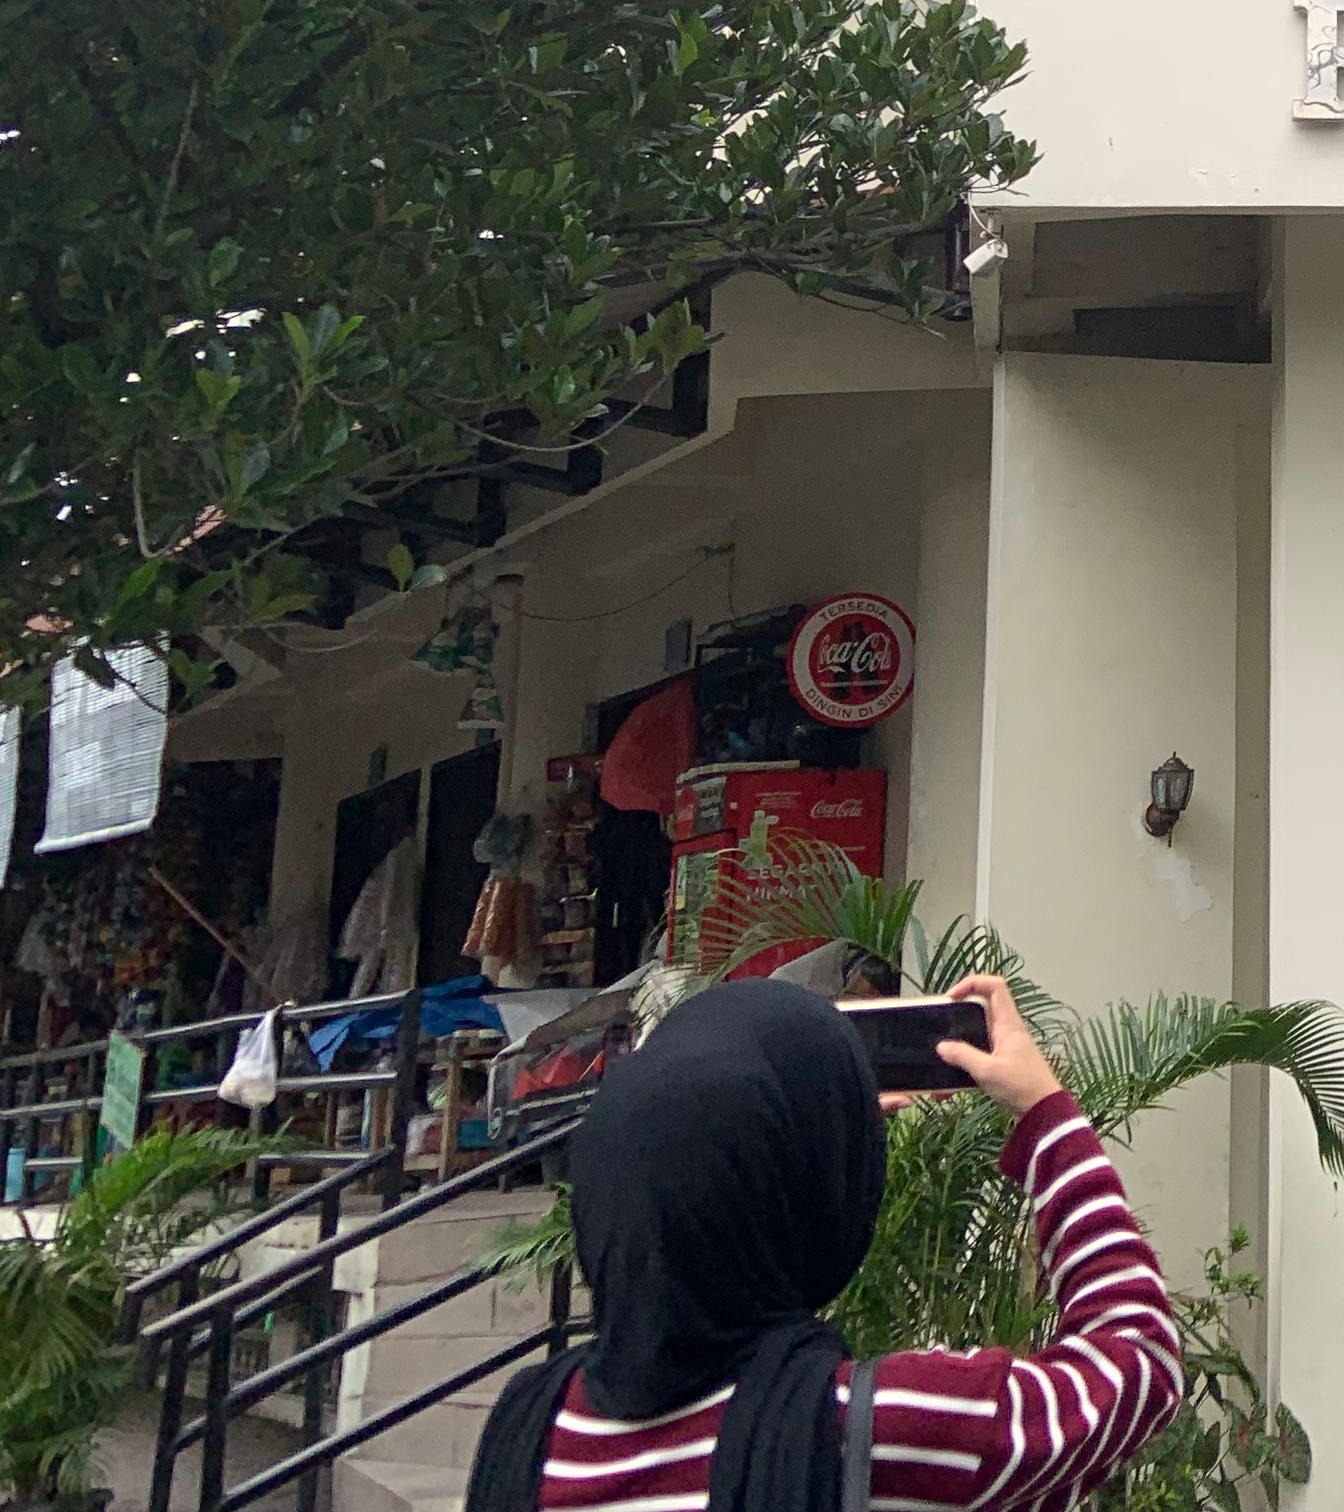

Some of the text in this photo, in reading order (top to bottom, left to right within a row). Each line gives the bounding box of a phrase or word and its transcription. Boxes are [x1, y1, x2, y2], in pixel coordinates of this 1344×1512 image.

[820, 601, 888, 620] TERSEDIA
[805, 688, 851, 718] DINGIN
[859, 707, 874, 718] DI
